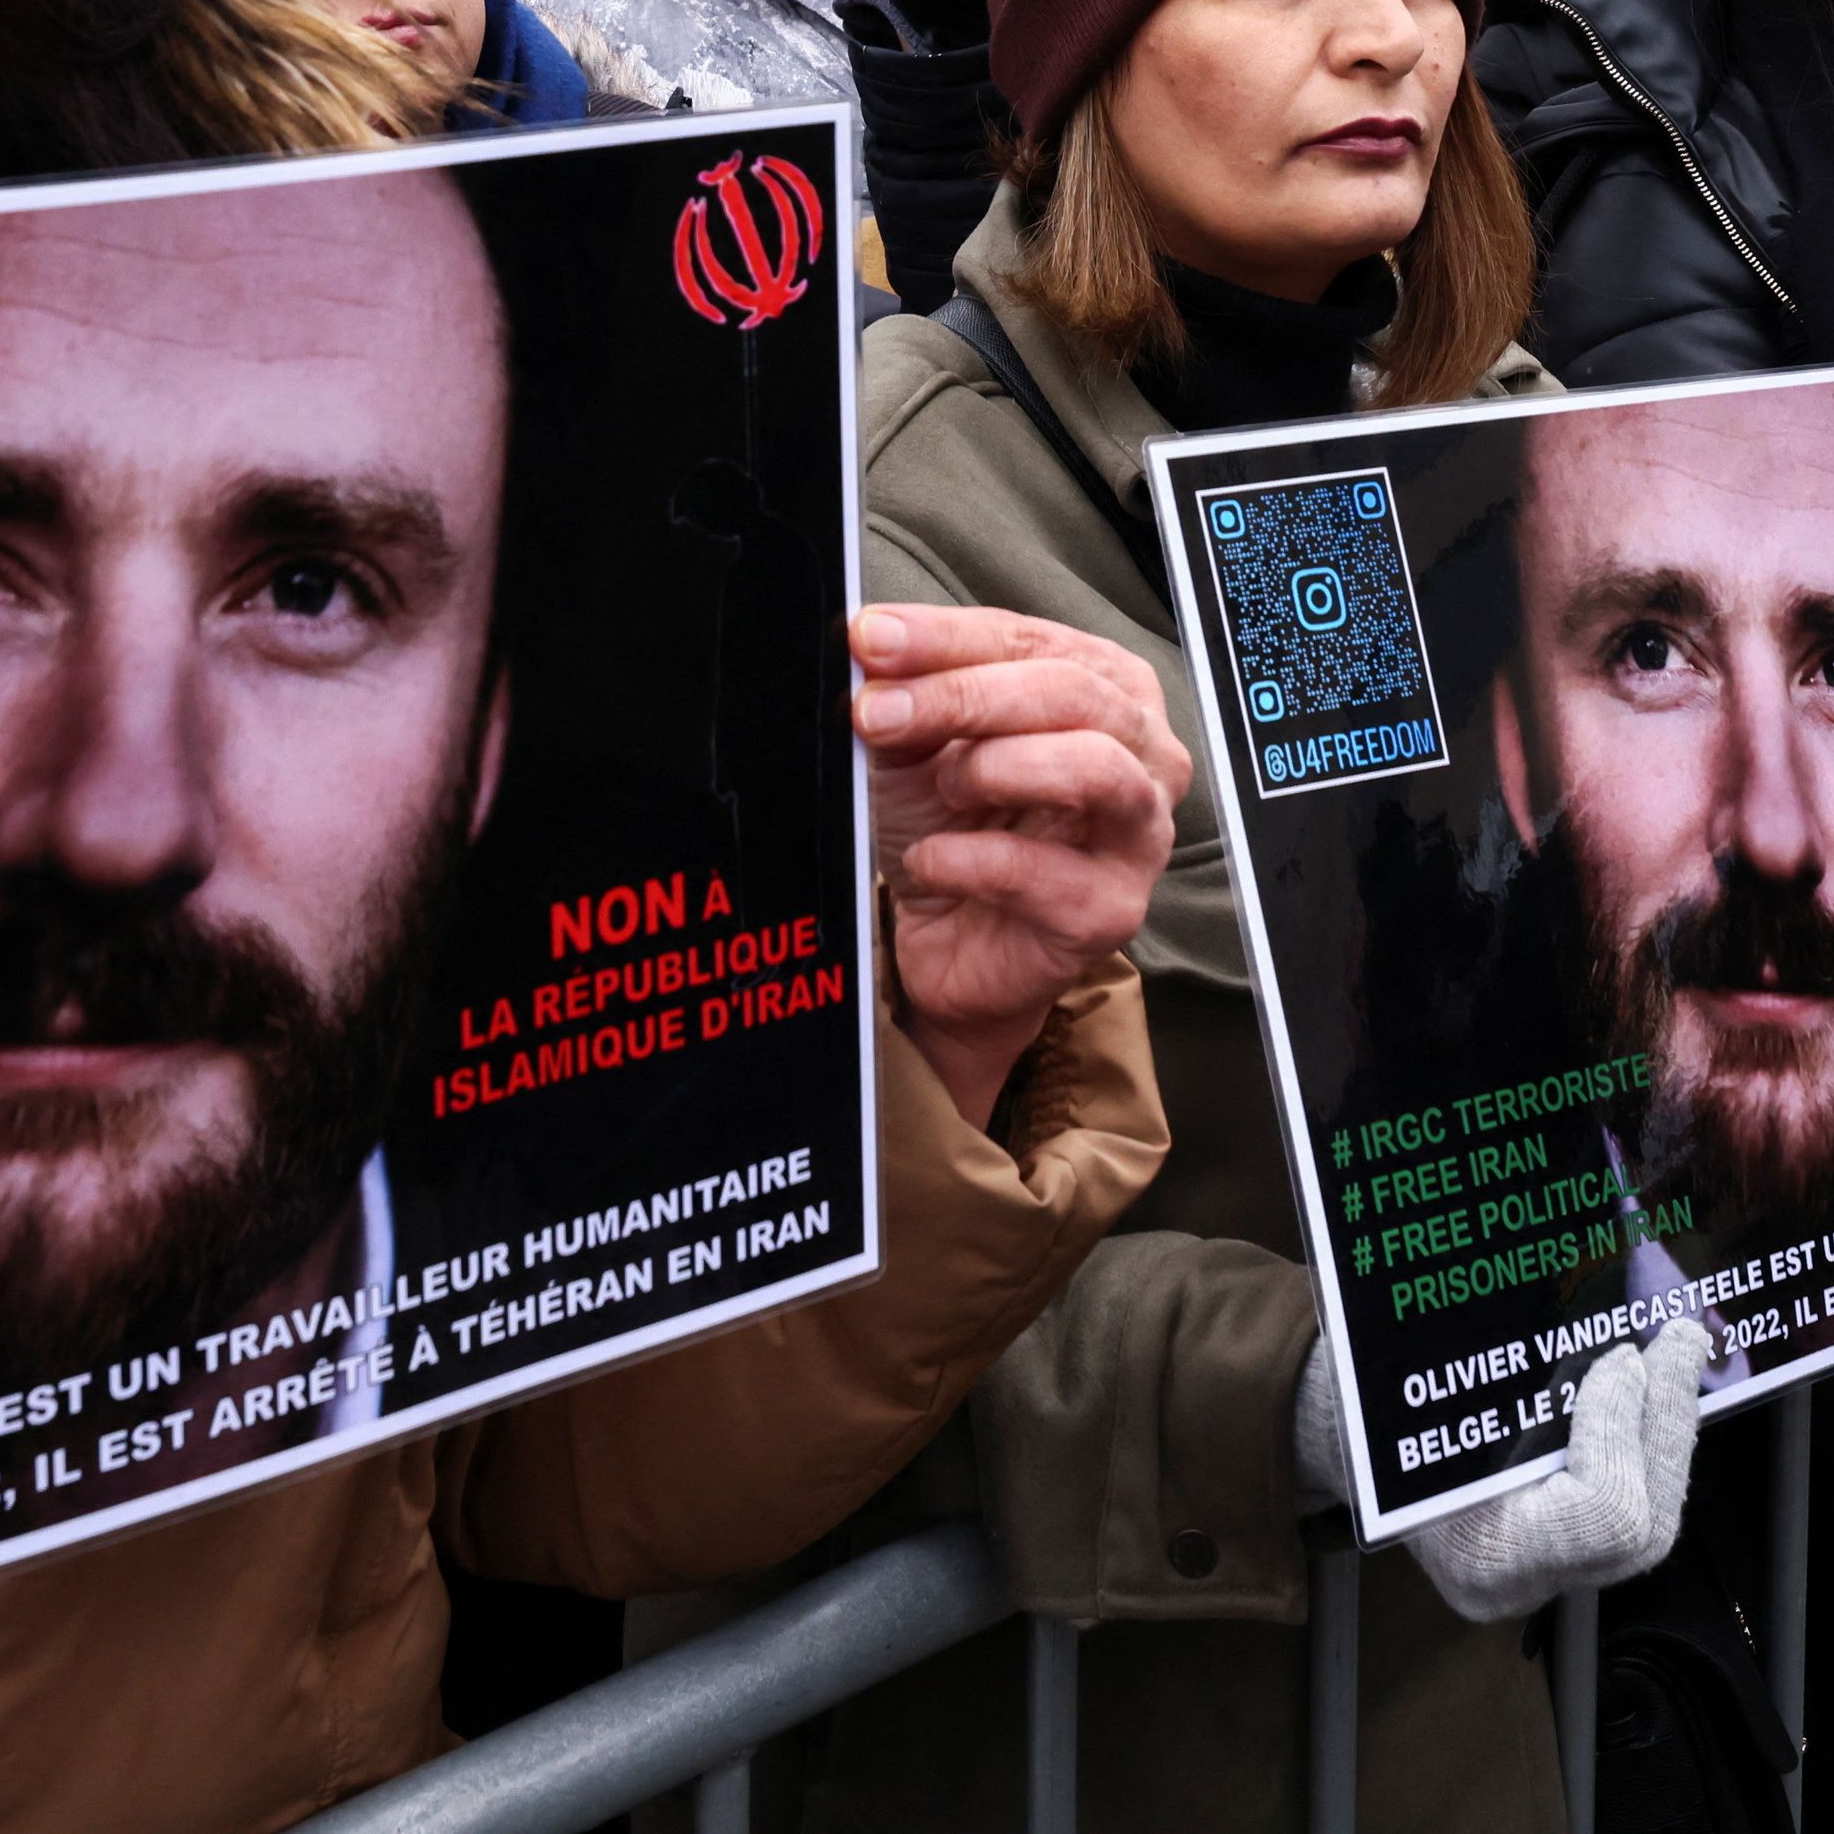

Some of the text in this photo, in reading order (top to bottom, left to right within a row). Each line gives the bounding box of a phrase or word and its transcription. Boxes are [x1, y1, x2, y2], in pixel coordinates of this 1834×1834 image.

[1263, 720, 1438, 783] @U4FREEDOM
[548, 869, 734, 961] NON À
[432, 963, 846, 1120] ISLAMIQUE D'IRAN
[457, 914, 821, 1052] LA RÉPUBLIQUE
[1360, 1052, 1652, 1160] IRGC TERRORISTE
[1371, 1133, 1548, 1215] FREE IRAN
[1381, 1162, 1641, 1267] FREE POLITICAL
[106, 1343, 183, 1405] UN
[194, 1240, 512, 1368] TRAVAILLEUR
[521, 1145, 813, 1271] HUMANITAIRE
[1391, 1221, 1616, 1322] PRISONERS IN
[1402, 1341, 1530, 1408] OLIVIER
[1534, 1259, 1765, 1364] VANDECASTEELE
[1769, 1240, 1816, 1283] EST
[32, 1446, 84, 1494] IL
[95, 1407, 195, 1475] EST
[207, 1333, 396, 1440] ARRÊTÉ
[407, 1324, 440, 1369] À
[449, 1261, 655, 1358] TÉHÉRAN
[665, 1236, 724, 1290] EN
[734, 1198, 832, 1264] IRAN
[1397, 1408, 1511, 1473] BELGE.
[1516, 1390, 1555, 1431] LE
[1723, 1311, 1791, 1357] 2022,
[1795, 1296, 1819, 1328] IL
